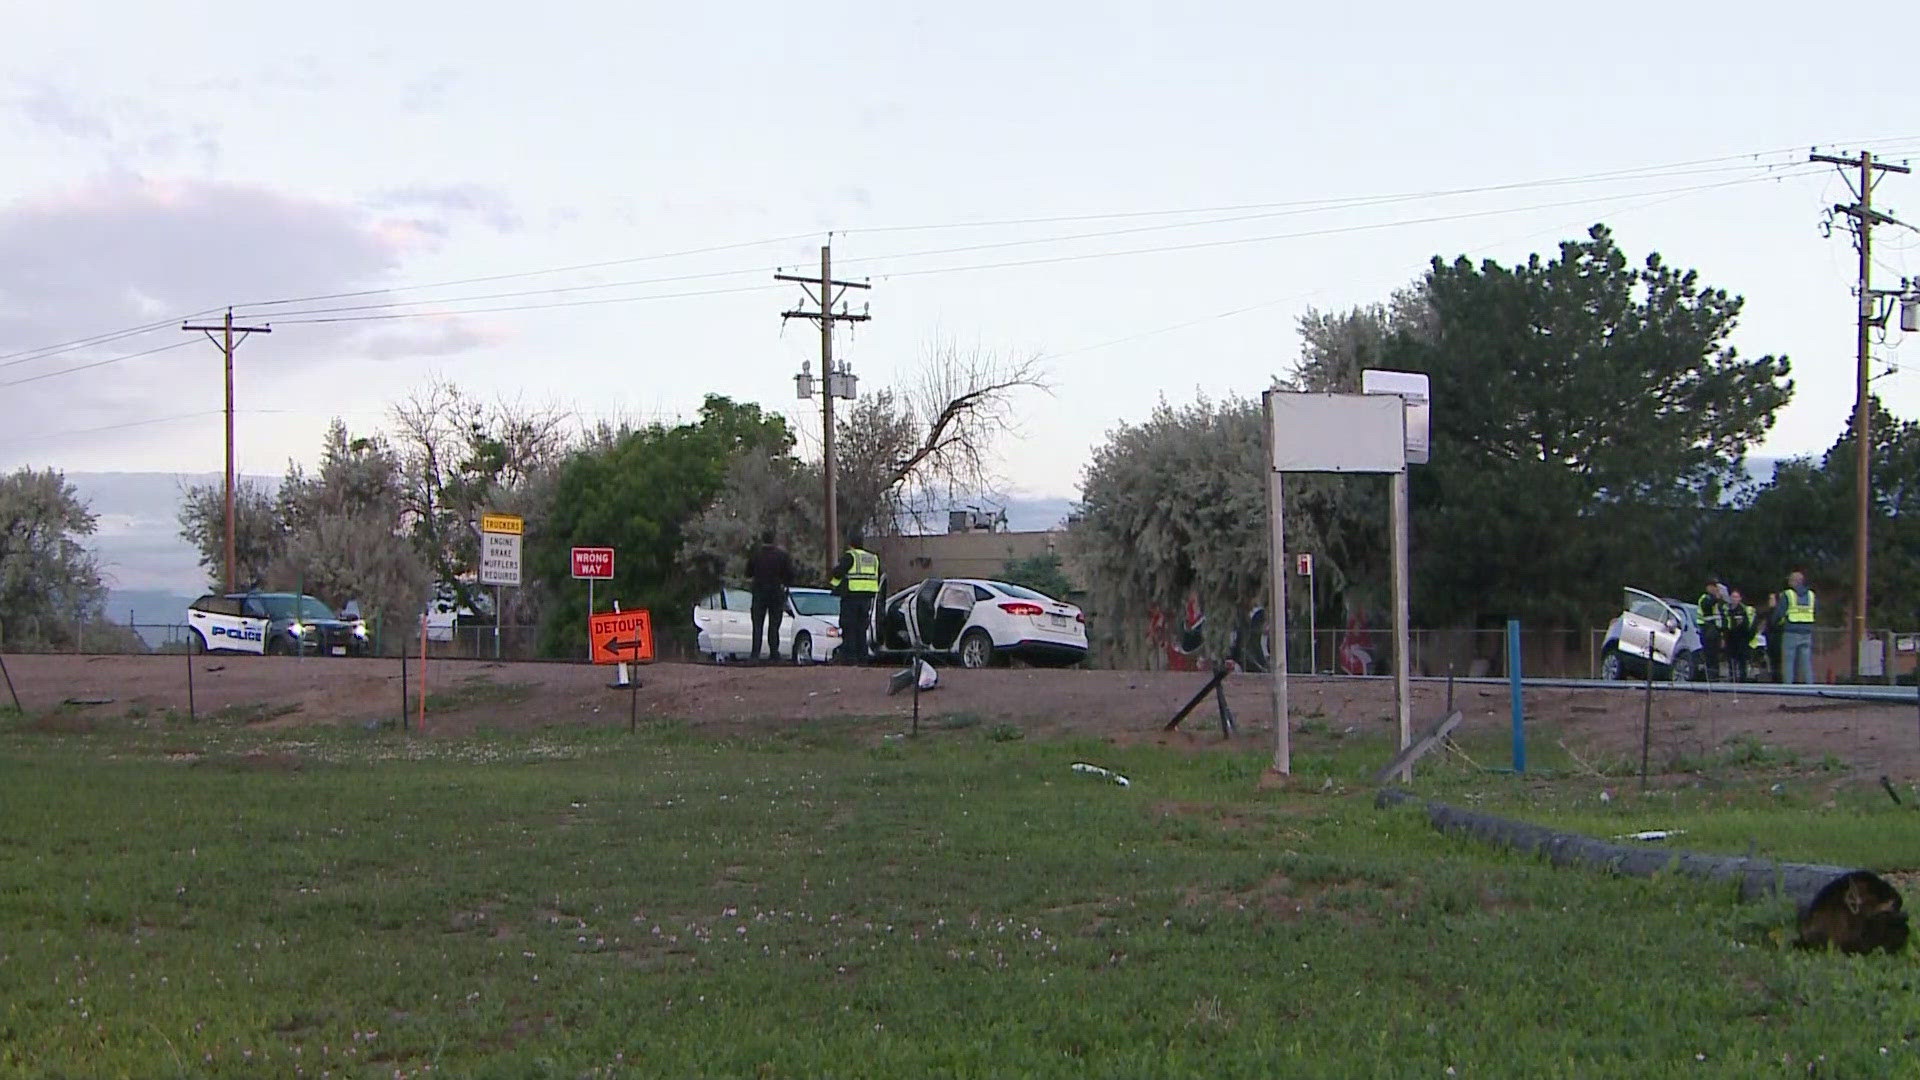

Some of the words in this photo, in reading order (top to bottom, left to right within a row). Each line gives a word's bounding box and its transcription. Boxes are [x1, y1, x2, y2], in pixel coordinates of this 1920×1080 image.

[486, 520, 520, 530] TRUCKERS
[490, 537, 513, 546] ENGINE
[490, 549, 512, 557] BRAKE
[576, 553, 609, 563] WRONG
[484, 560, 518, 569] MUFFLERS
[581, 565, 602, 574] WAY
[484, 571, 518, 580] REQUIRED
[595, 619, 644, 634] DETOUR
[212, 626, 262, 641] POLICE
